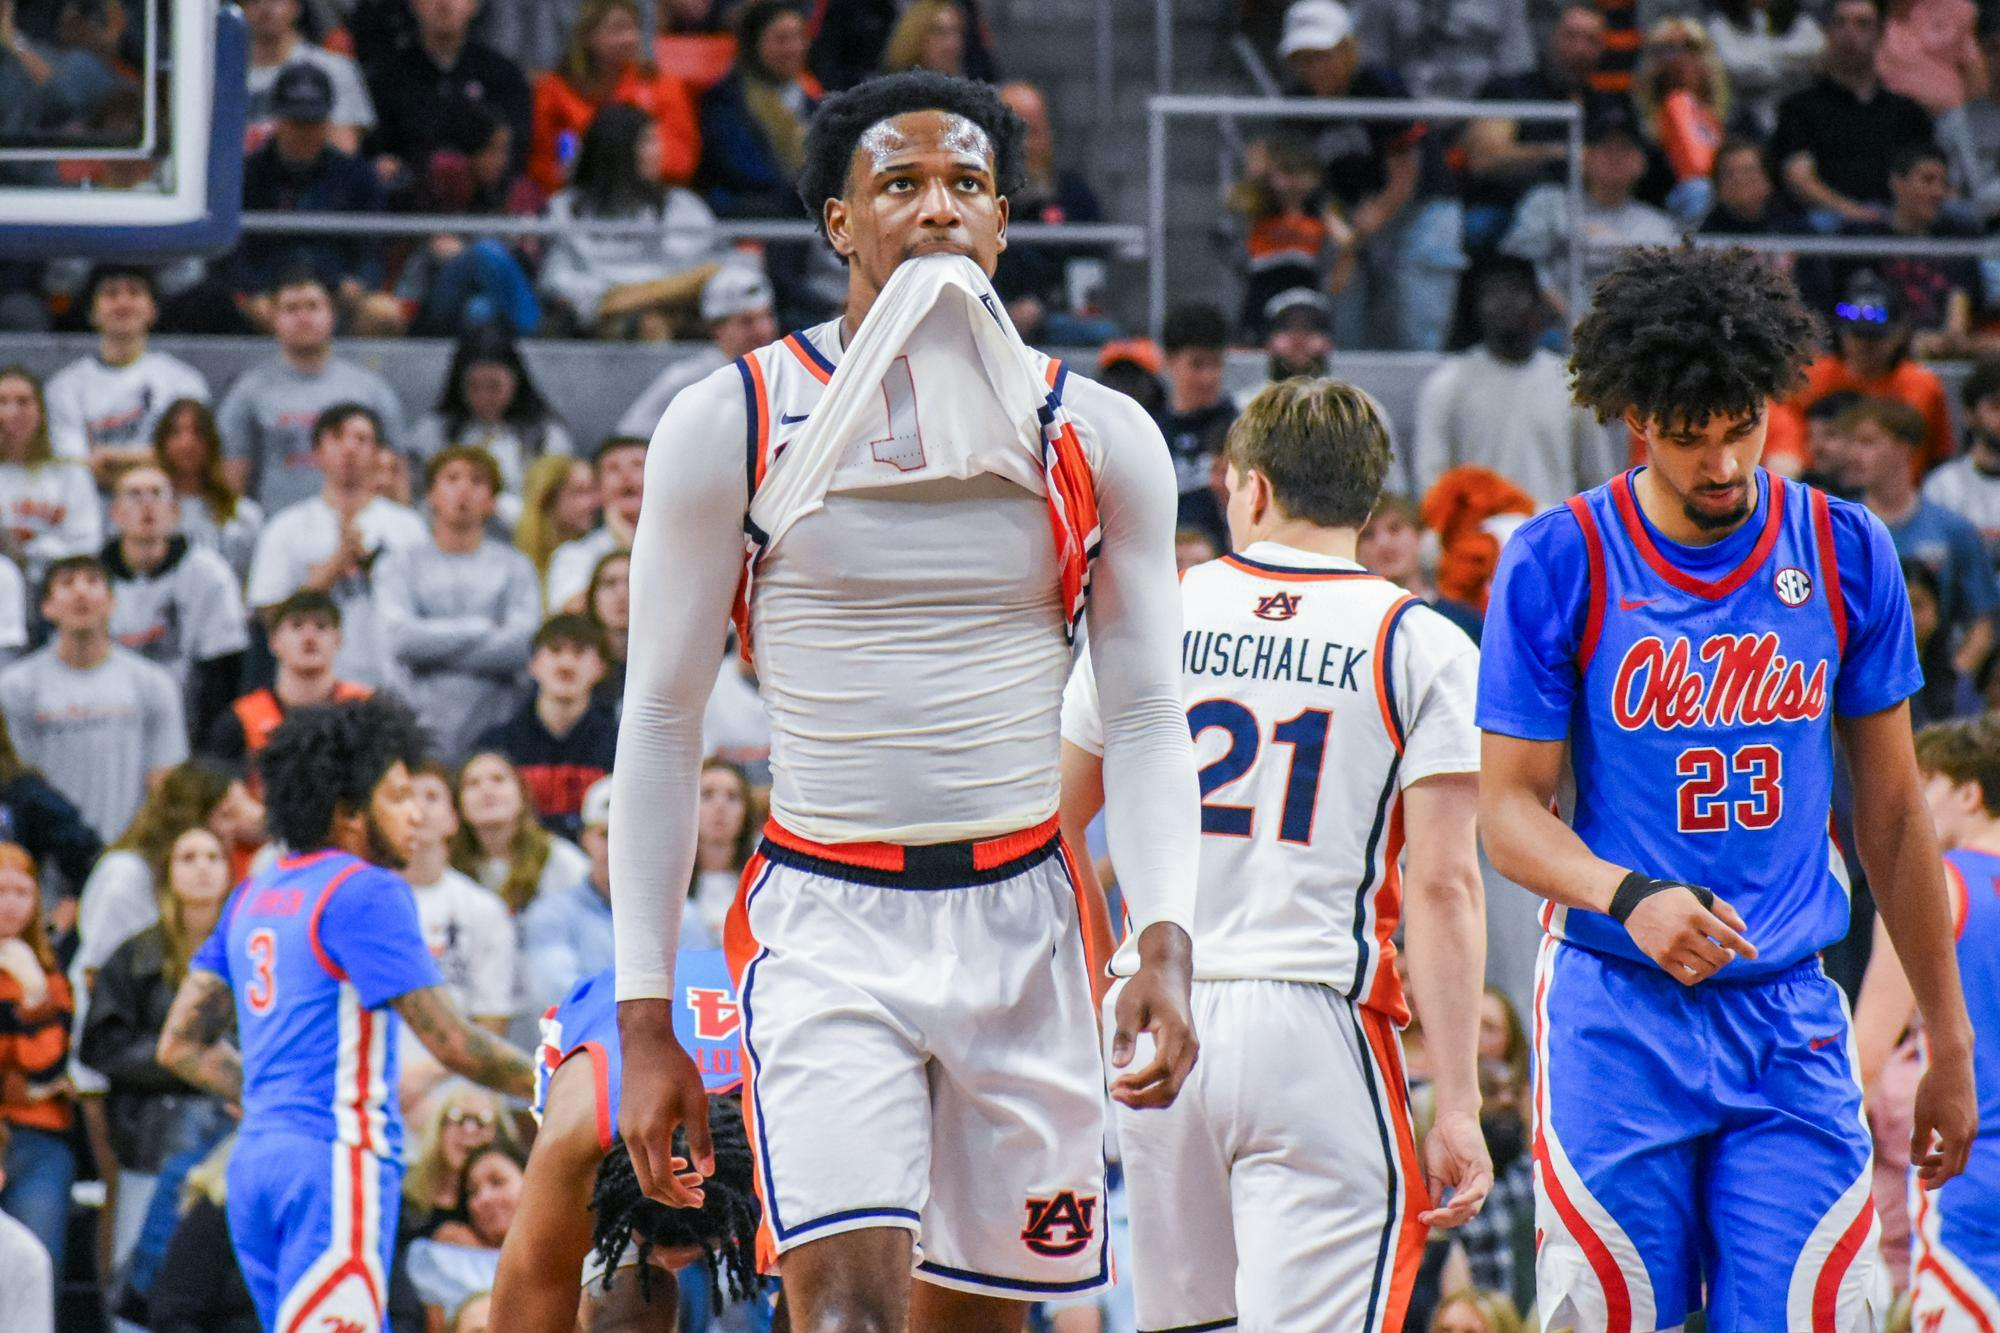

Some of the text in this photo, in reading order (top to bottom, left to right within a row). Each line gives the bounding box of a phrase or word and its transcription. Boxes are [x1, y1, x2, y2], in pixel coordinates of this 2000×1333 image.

[1775, 567, 1811, 606] SEC
[1612, 631, 1827, 731] Ole Miss
[1186, 697, 1333, 847] 21
[1676, 744, 1782, 832] 23
[245, 929, 277, 1016] 3
[686, 986, 741, 1041] 4
